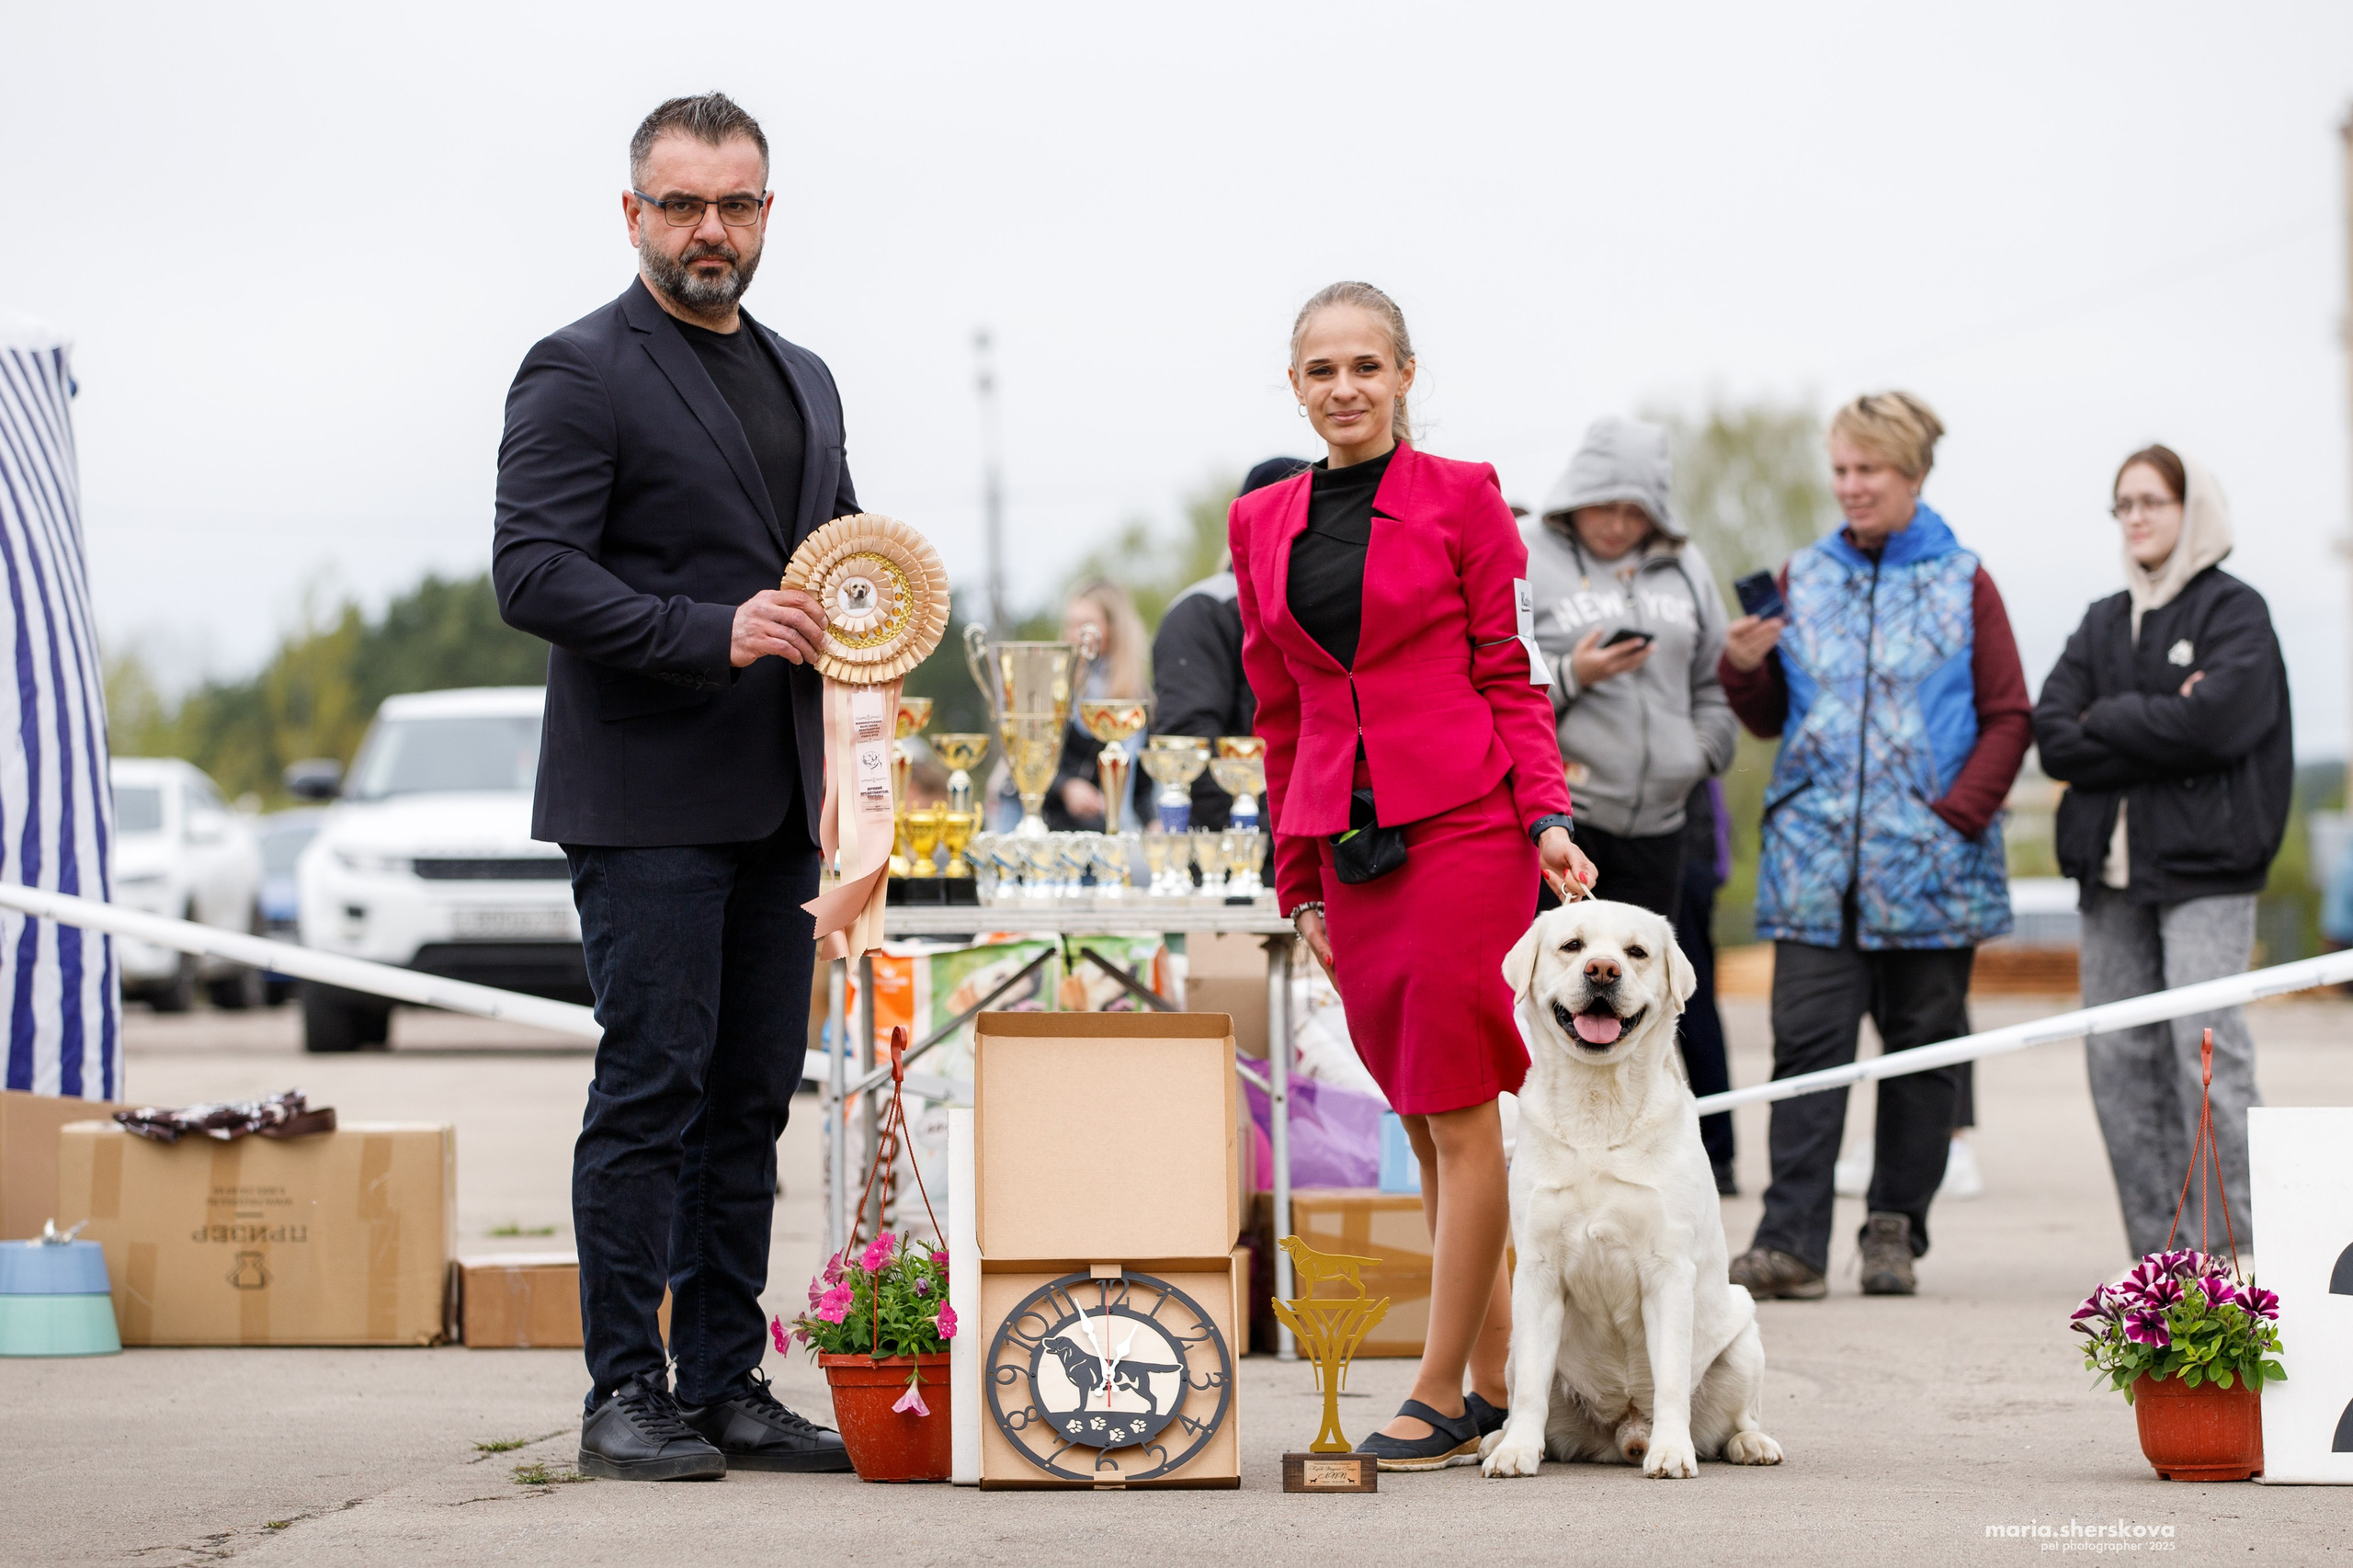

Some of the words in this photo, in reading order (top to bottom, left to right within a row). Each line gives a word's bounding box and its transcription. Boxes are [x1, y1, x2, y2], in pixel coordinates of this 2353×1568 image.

[1552, 590, 1625, 633] NEW
[191, 1223, 307, 1243] ПРИЗЕР
[1044, 1287, 1079, 1320] 11
[1096, 1278, 1130, 1307] 12
[1004, 1312, 1049, 1358] 10
[1173, 1324, 1212, 1352] 2
[995, 1364, 1030, 1385] 9
[1188, 1369, 1224, 1391] 3
[1006, 1405, 1041, 1431] 8
[1176, 1412, 1211, 1436] 4
[1047, 1434, 1078, 1464] 7
[1096, 1447, 1120, 1471] 6
[1141, 1441, 1168, 1470] 5
